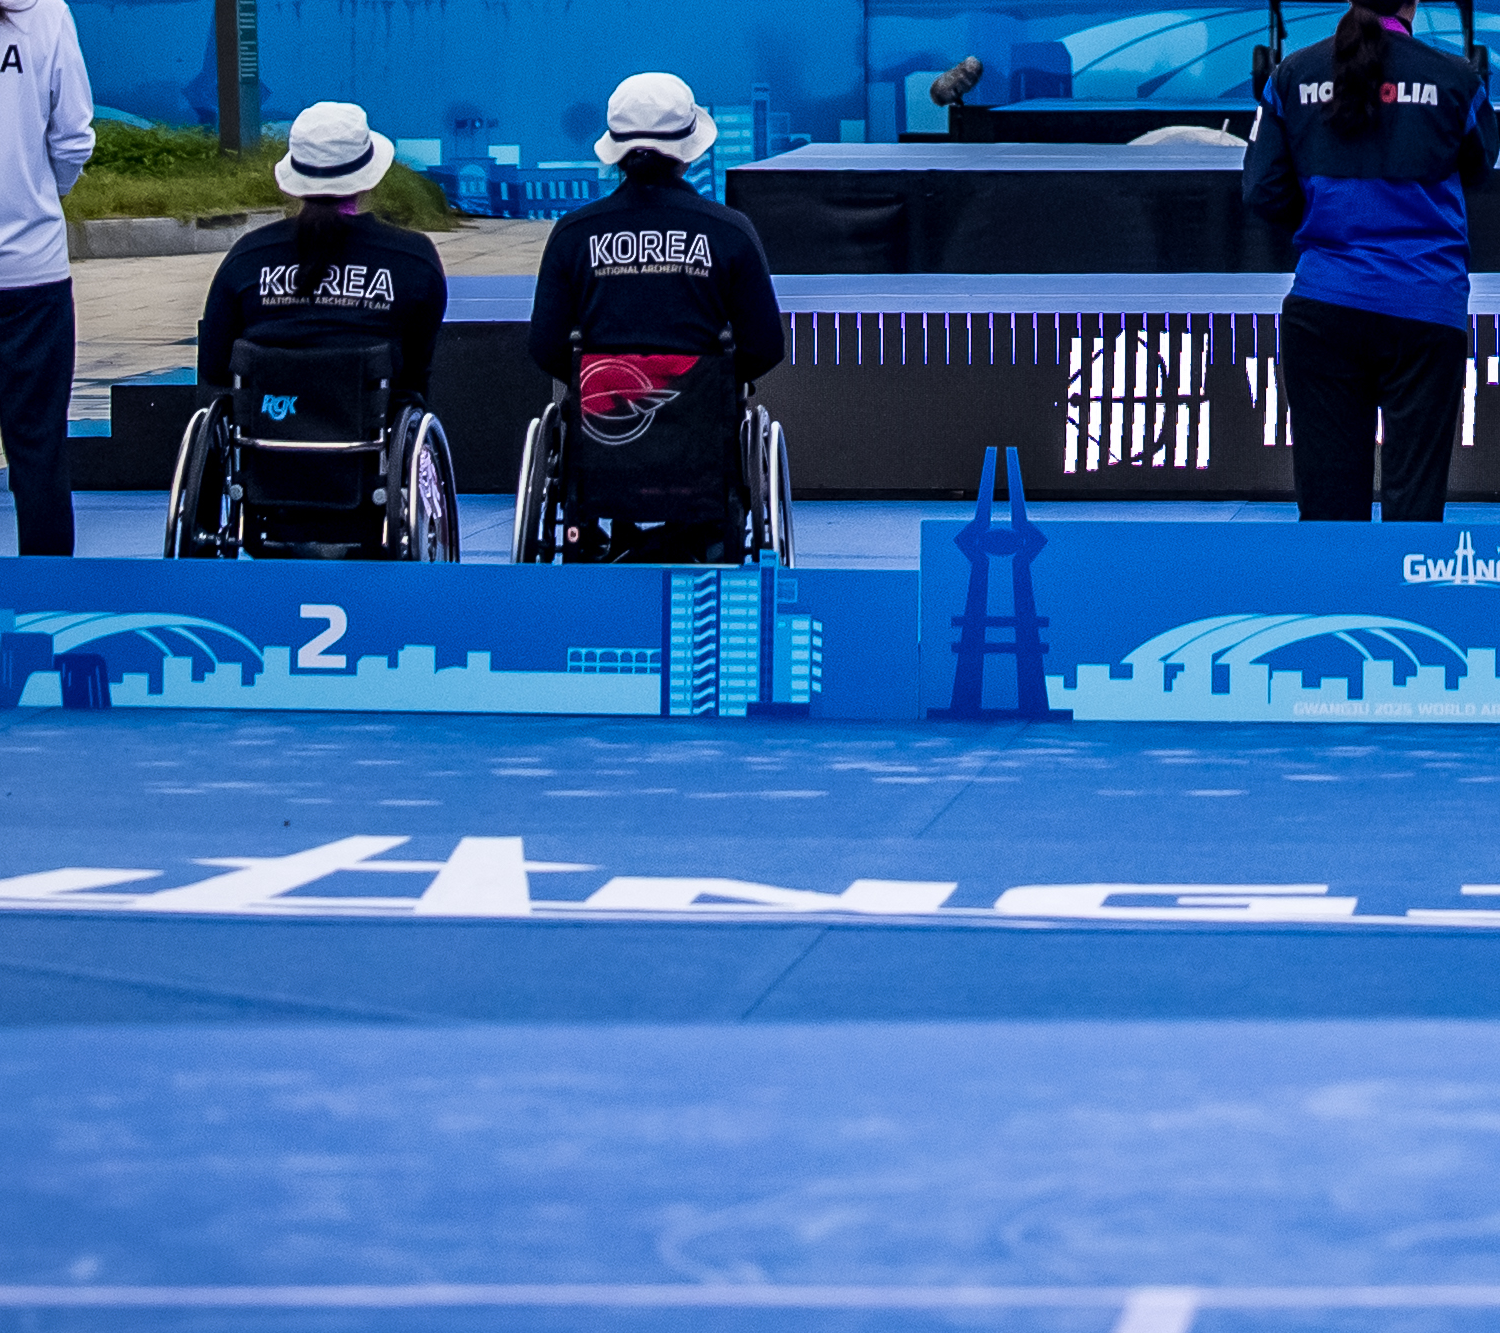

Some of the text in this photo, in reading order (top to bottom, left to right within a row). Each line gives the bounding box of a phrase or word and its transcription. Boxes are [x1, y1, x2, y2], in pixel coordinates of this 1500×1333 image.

[1299, 81, 1439, 106] MOOLIA
[589, 230, 713, 268] KOREA
[297, 603, 349, 670] 2
[1293, 702, 1370, 717] GWANGJU
[1374, 702, 1413, 717] 2025
[1418, 702, 1477, 718] WORLD
